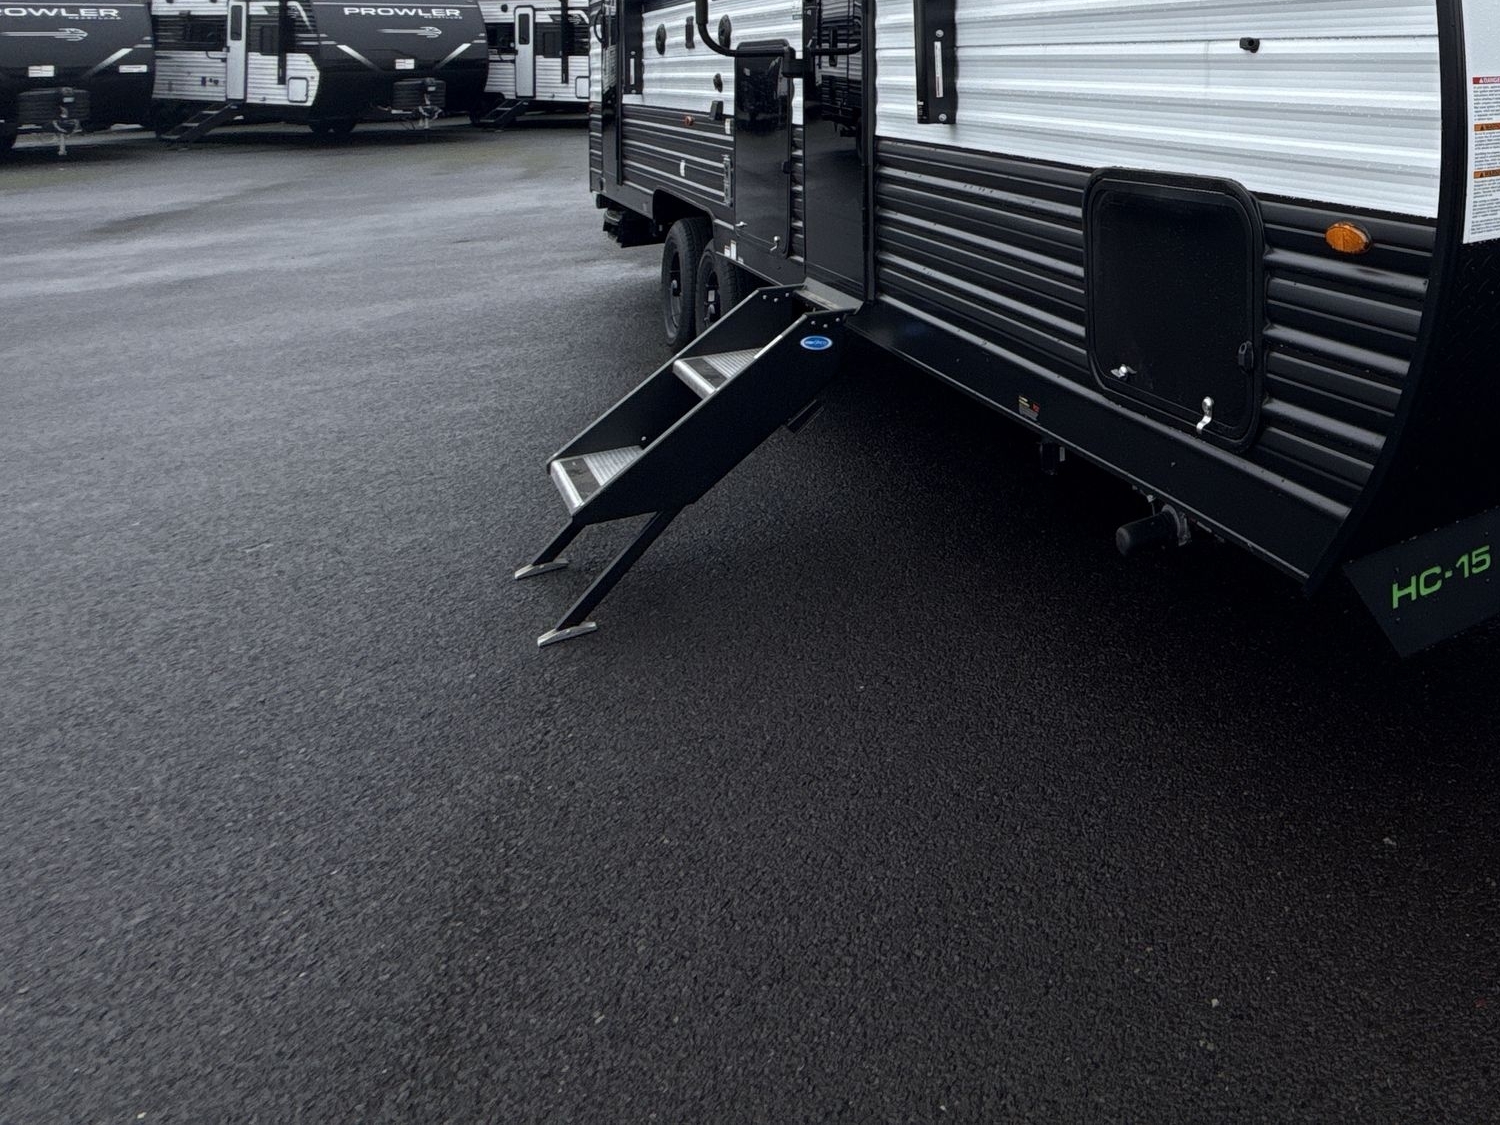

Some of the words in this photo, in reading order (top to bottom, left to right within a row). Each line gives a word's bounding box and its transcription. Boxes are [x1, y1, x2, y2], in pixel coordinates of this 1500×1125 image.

[0, 7, 119, 17] OWLER
[343, 7, 461, 17] PROWLER
[1392, 545, 1491, 609] HC-15
